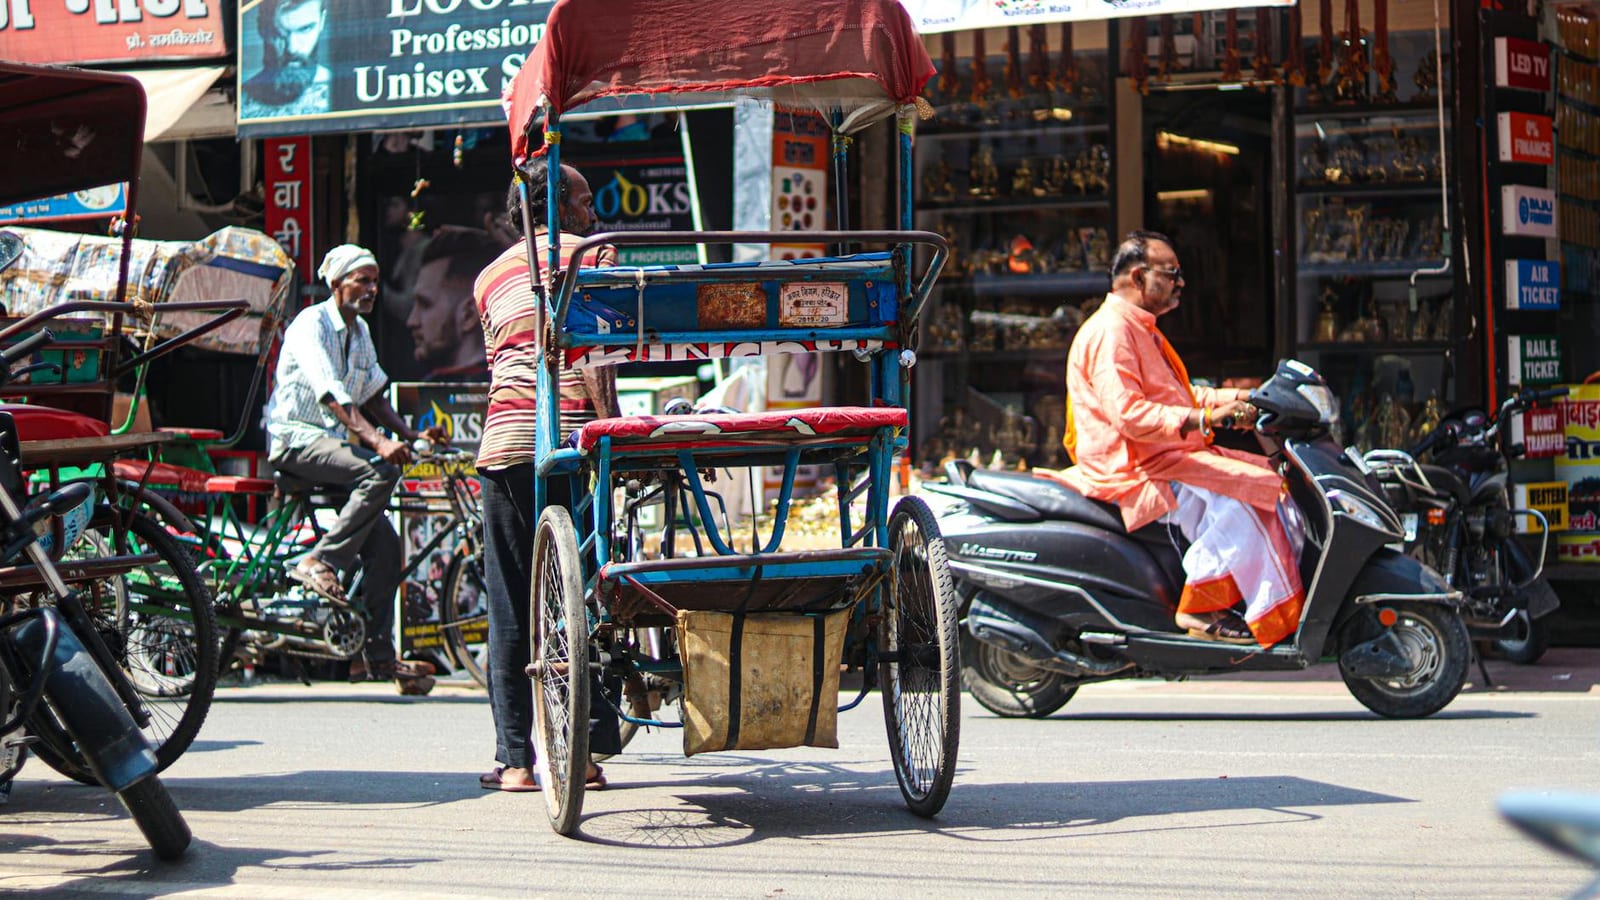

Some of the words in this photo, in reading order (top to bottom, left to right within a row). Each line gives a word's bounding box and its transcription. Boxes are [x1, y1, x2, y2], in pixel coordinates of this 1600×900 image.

[390, 19, 548, 57] Profession
[1511, 52, 1531, 74] LED
[1533, 56, 1548, 77] TV
[353, 62, 490, 102] Unisex
[595, 170, 691, 218] OOKS
[1531, 266, 1549, 283] AIR
[1522, 286, 1558, 304] TICKET
[1526, 340, 1548, 358] RAIL
[1551, 341, 1557, 357] E
[1524, 361, 1560, 380] TICKET
[1532, 414, 1557, 432] MONEY
[1527, 434, 1564, 452] TRANSFER
[1529, 488, 1566, 505] WESTERN
[959, 543, 1038, 561] MAESTRO
